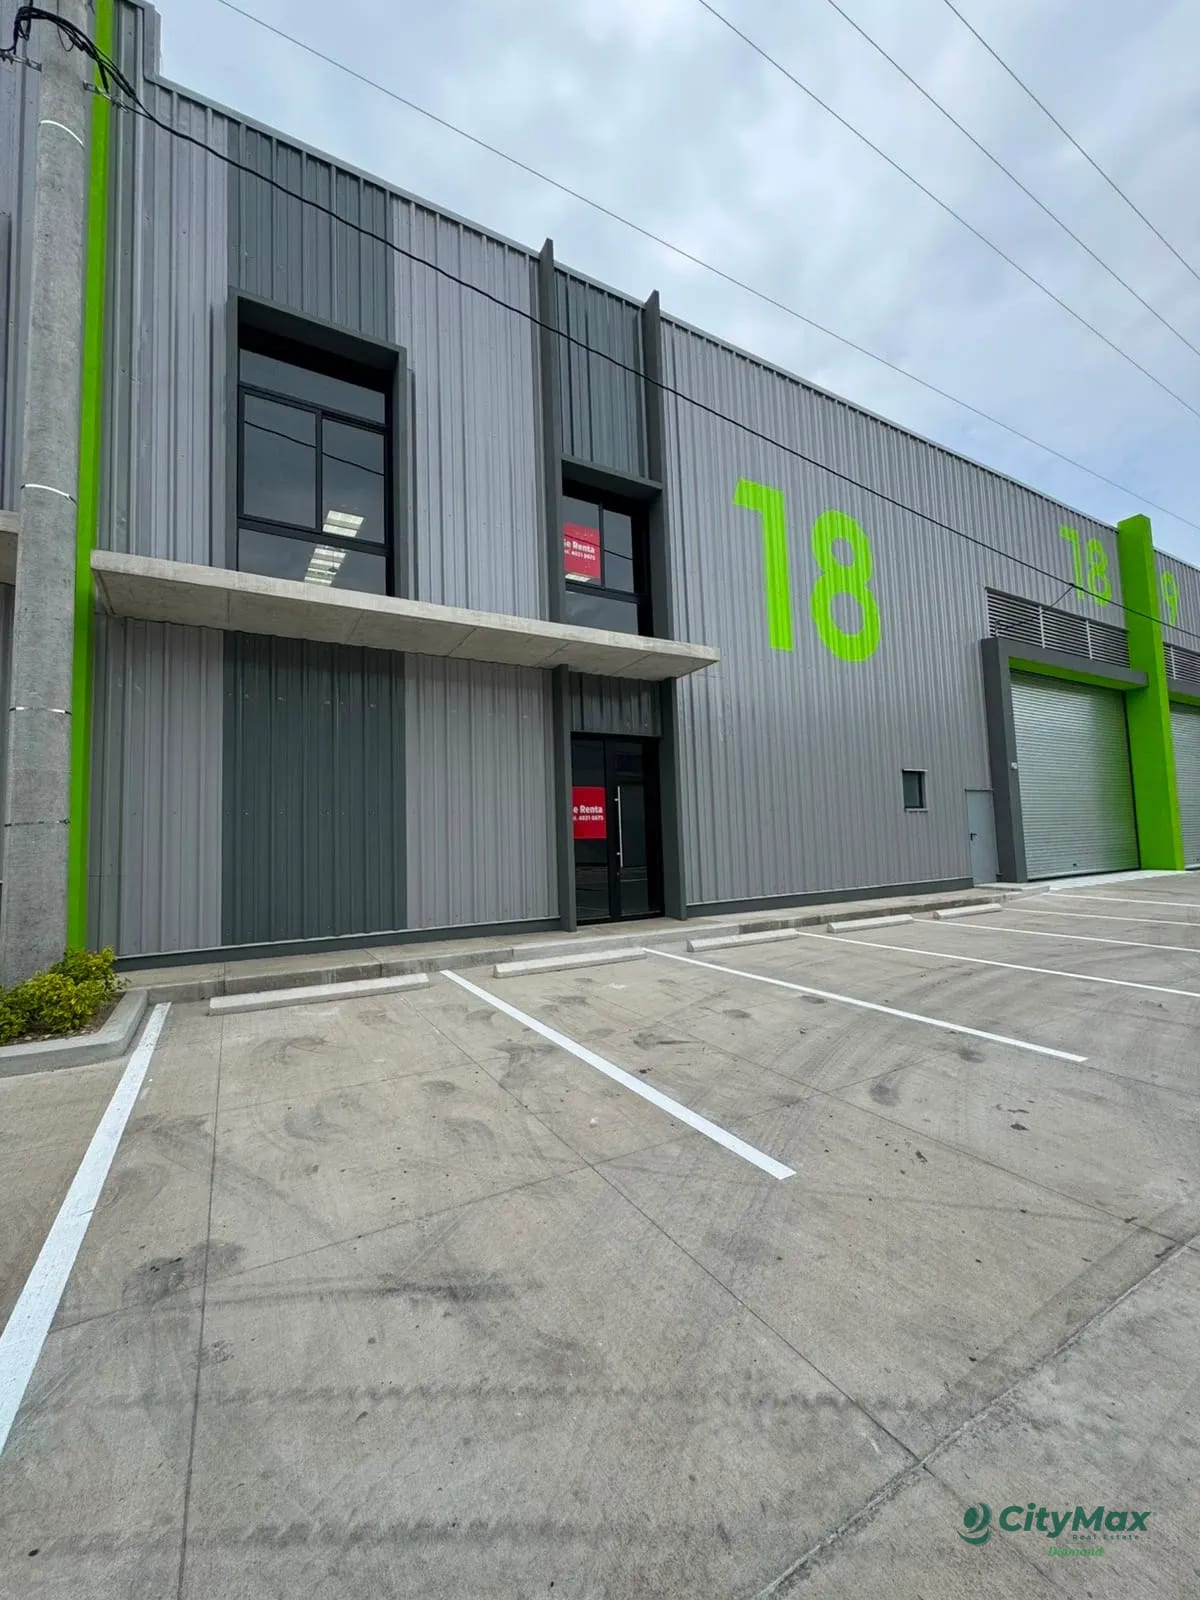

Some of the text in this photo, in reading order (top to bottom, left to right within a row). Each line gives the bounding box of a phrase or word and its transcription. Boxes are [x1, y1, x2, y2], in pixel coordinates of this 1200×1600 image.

[572, 541, 595, 554] Renta
[732, 476, 881, 663] 18
[1058, 523, 1113, 607] 18
[580, 804, 603, 814] Renta
